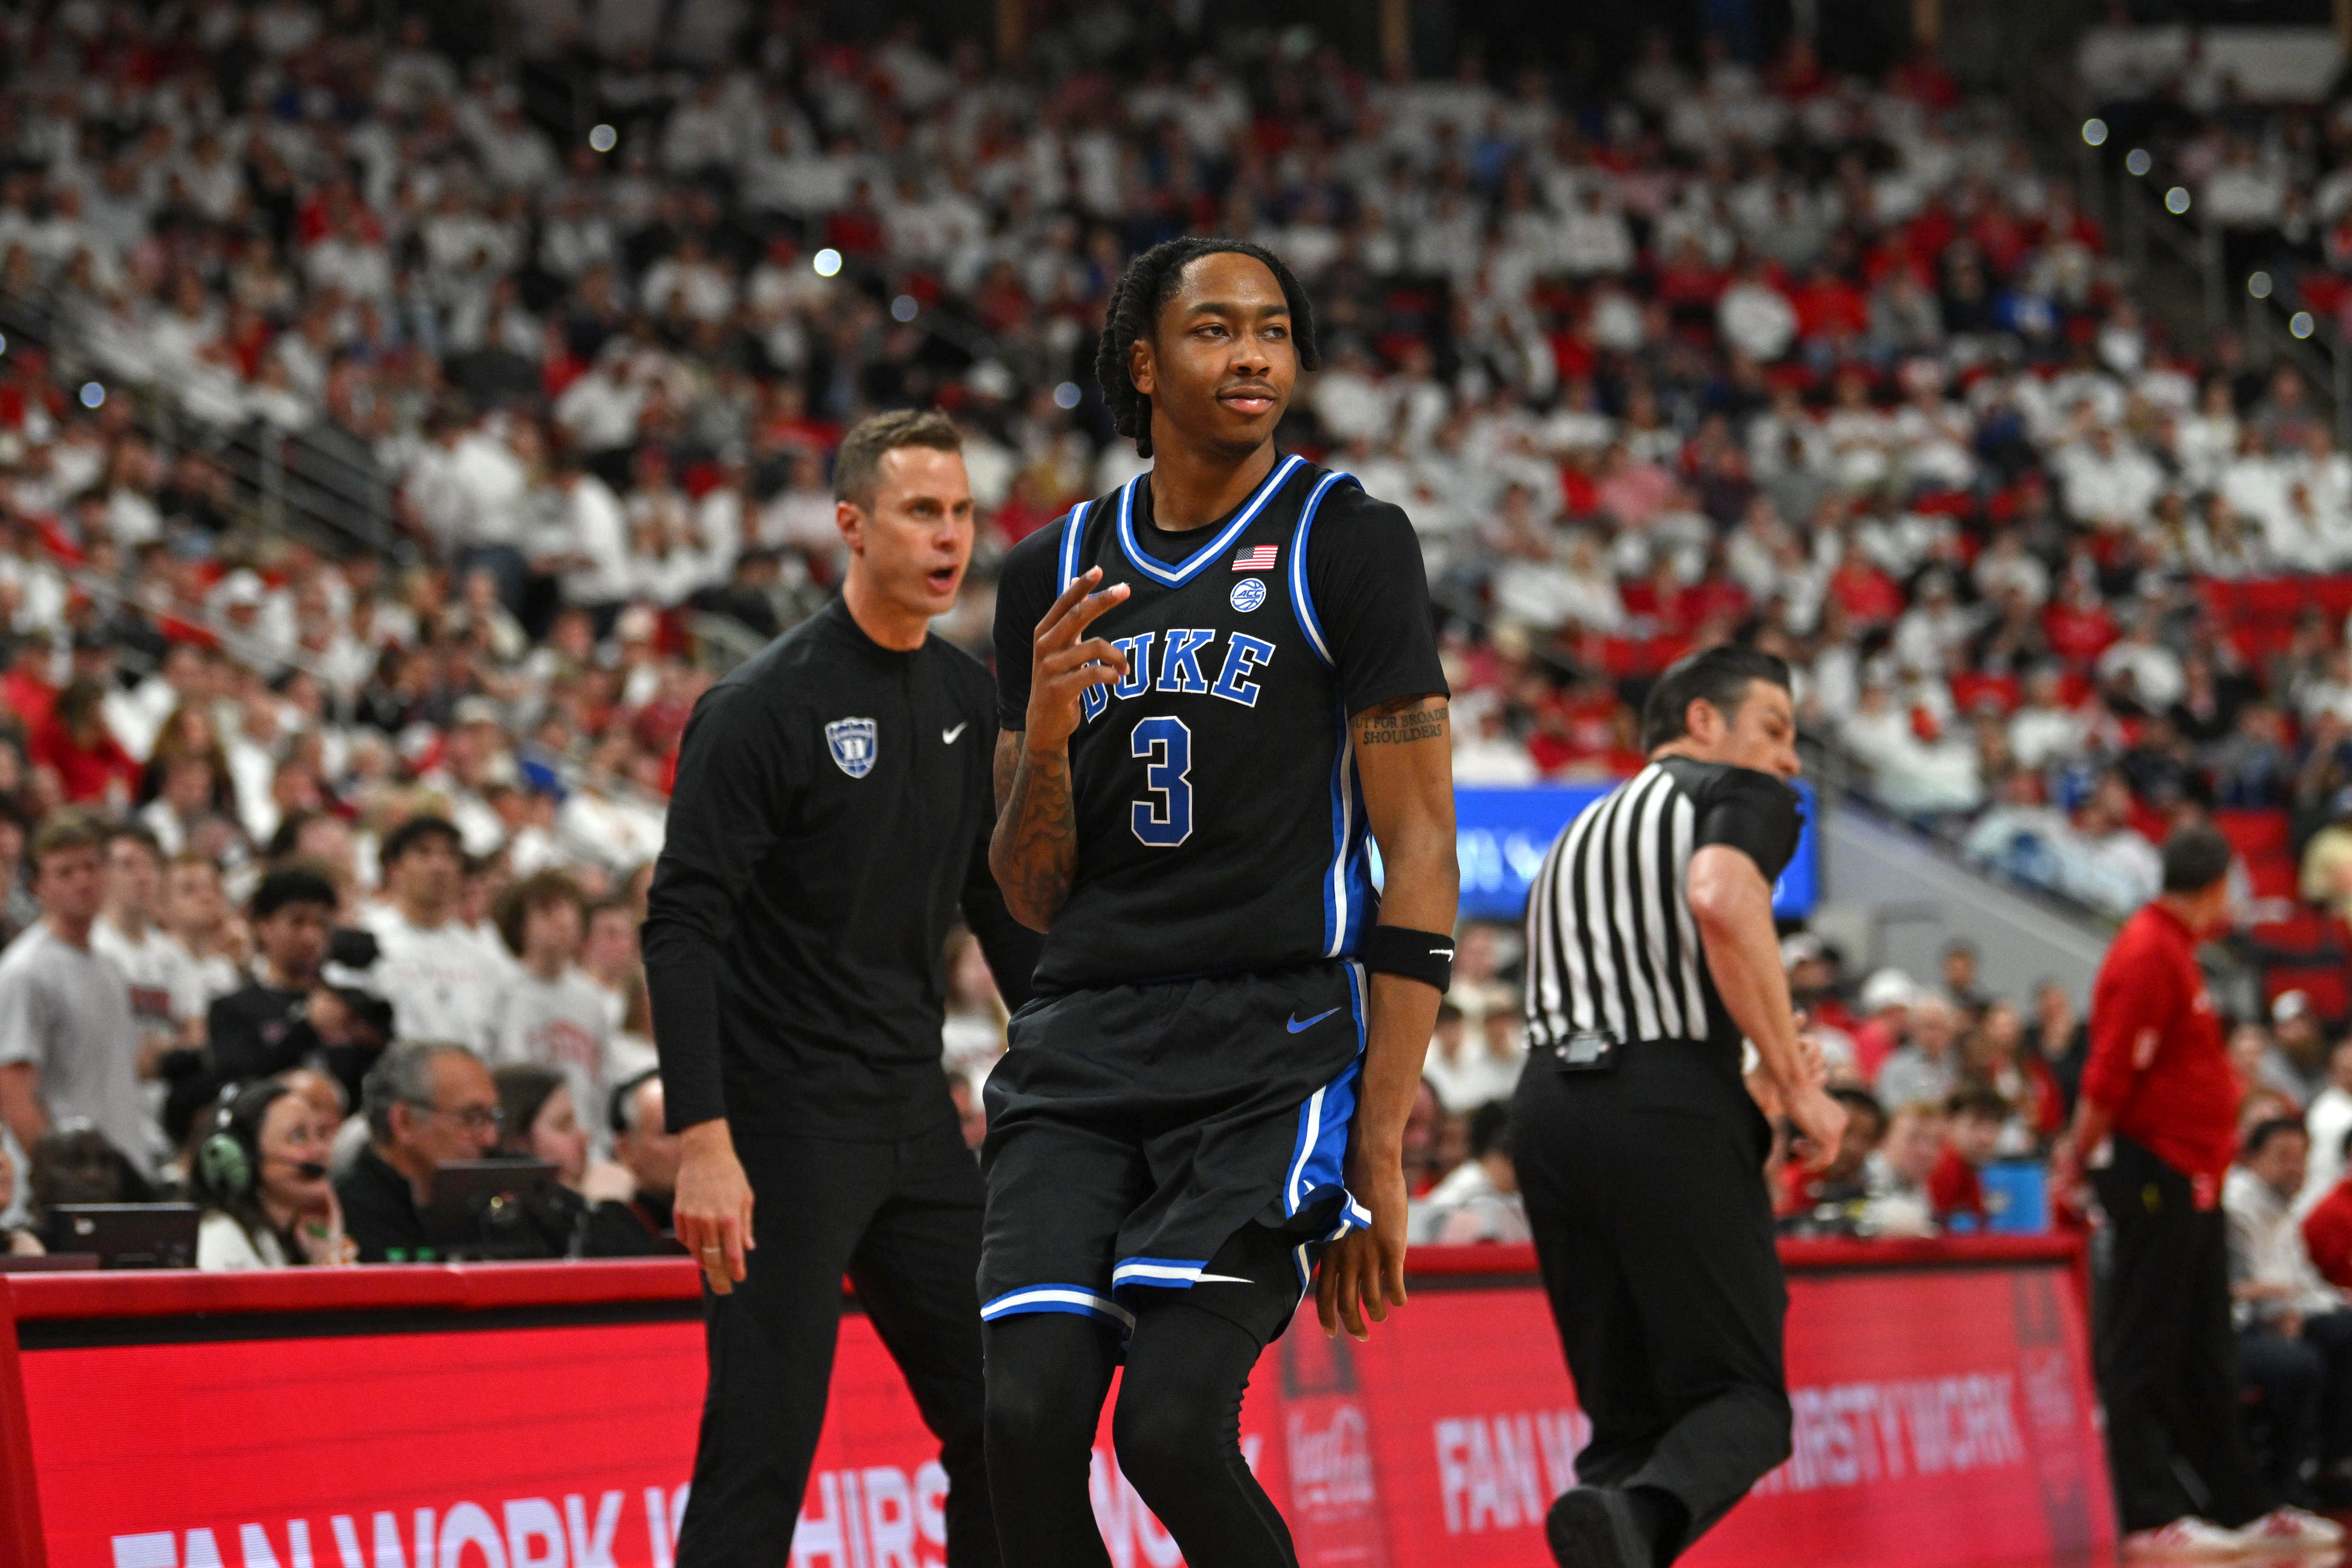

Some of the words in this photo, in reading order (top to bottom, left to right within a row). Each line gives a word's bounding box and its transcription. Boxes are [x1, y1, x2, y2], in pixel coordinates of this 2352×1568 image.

[1353, 716, 1369, 728] UT
[1374, 716, 1397, 728] FOR
[1401, 707, 1447, 727] BROADE
[1363, 724, 1442, 745] SHOULDERS
[1131, 716, 1193, 847] 3
[1434, 1413, 1545, 1536] FAN
